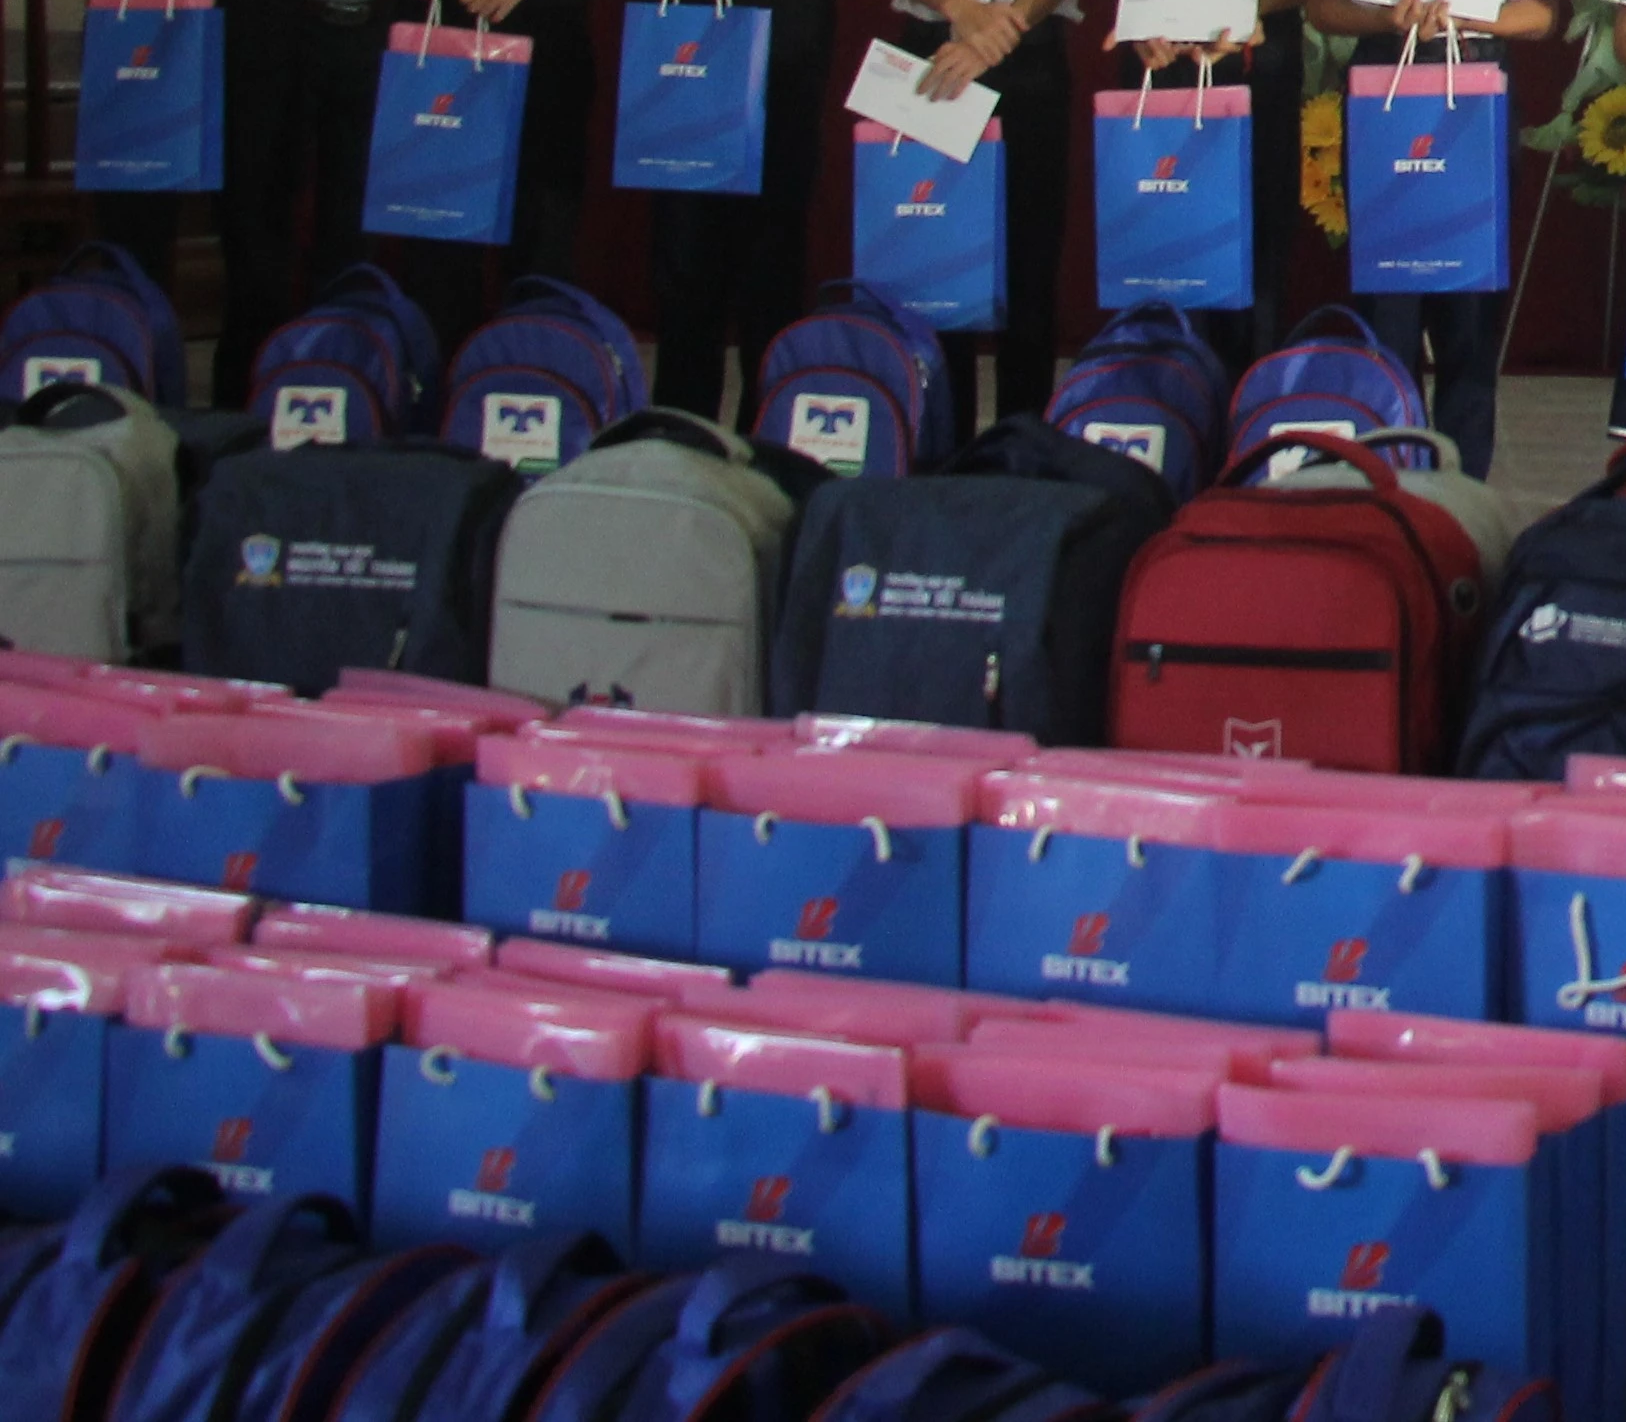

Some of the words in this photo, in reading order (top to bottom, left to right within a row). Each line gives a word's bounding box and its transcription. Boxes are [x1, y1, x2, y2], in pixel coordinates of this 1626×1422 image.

[660, 64, 706, 77] BITEX
[414, 113, 461, 128] BITEX
[1394, 159, 1444, 172] BITEX
[1138, 179, 1187, 192] BITEX
[896, 203, 944, 216] BITEX
[530, 911, 608, 938] BITEX
[770, 940, 859, 967] BITEX
[1042, 955, 1127, 985] BITEX
[1296, 983, 1390, 1010] BITEX
[449, 1190, 533, 1225] BITEX
[716, 1222, 811, 1252] BITEX
[990, 1257, 1090, 1287] BITEX
